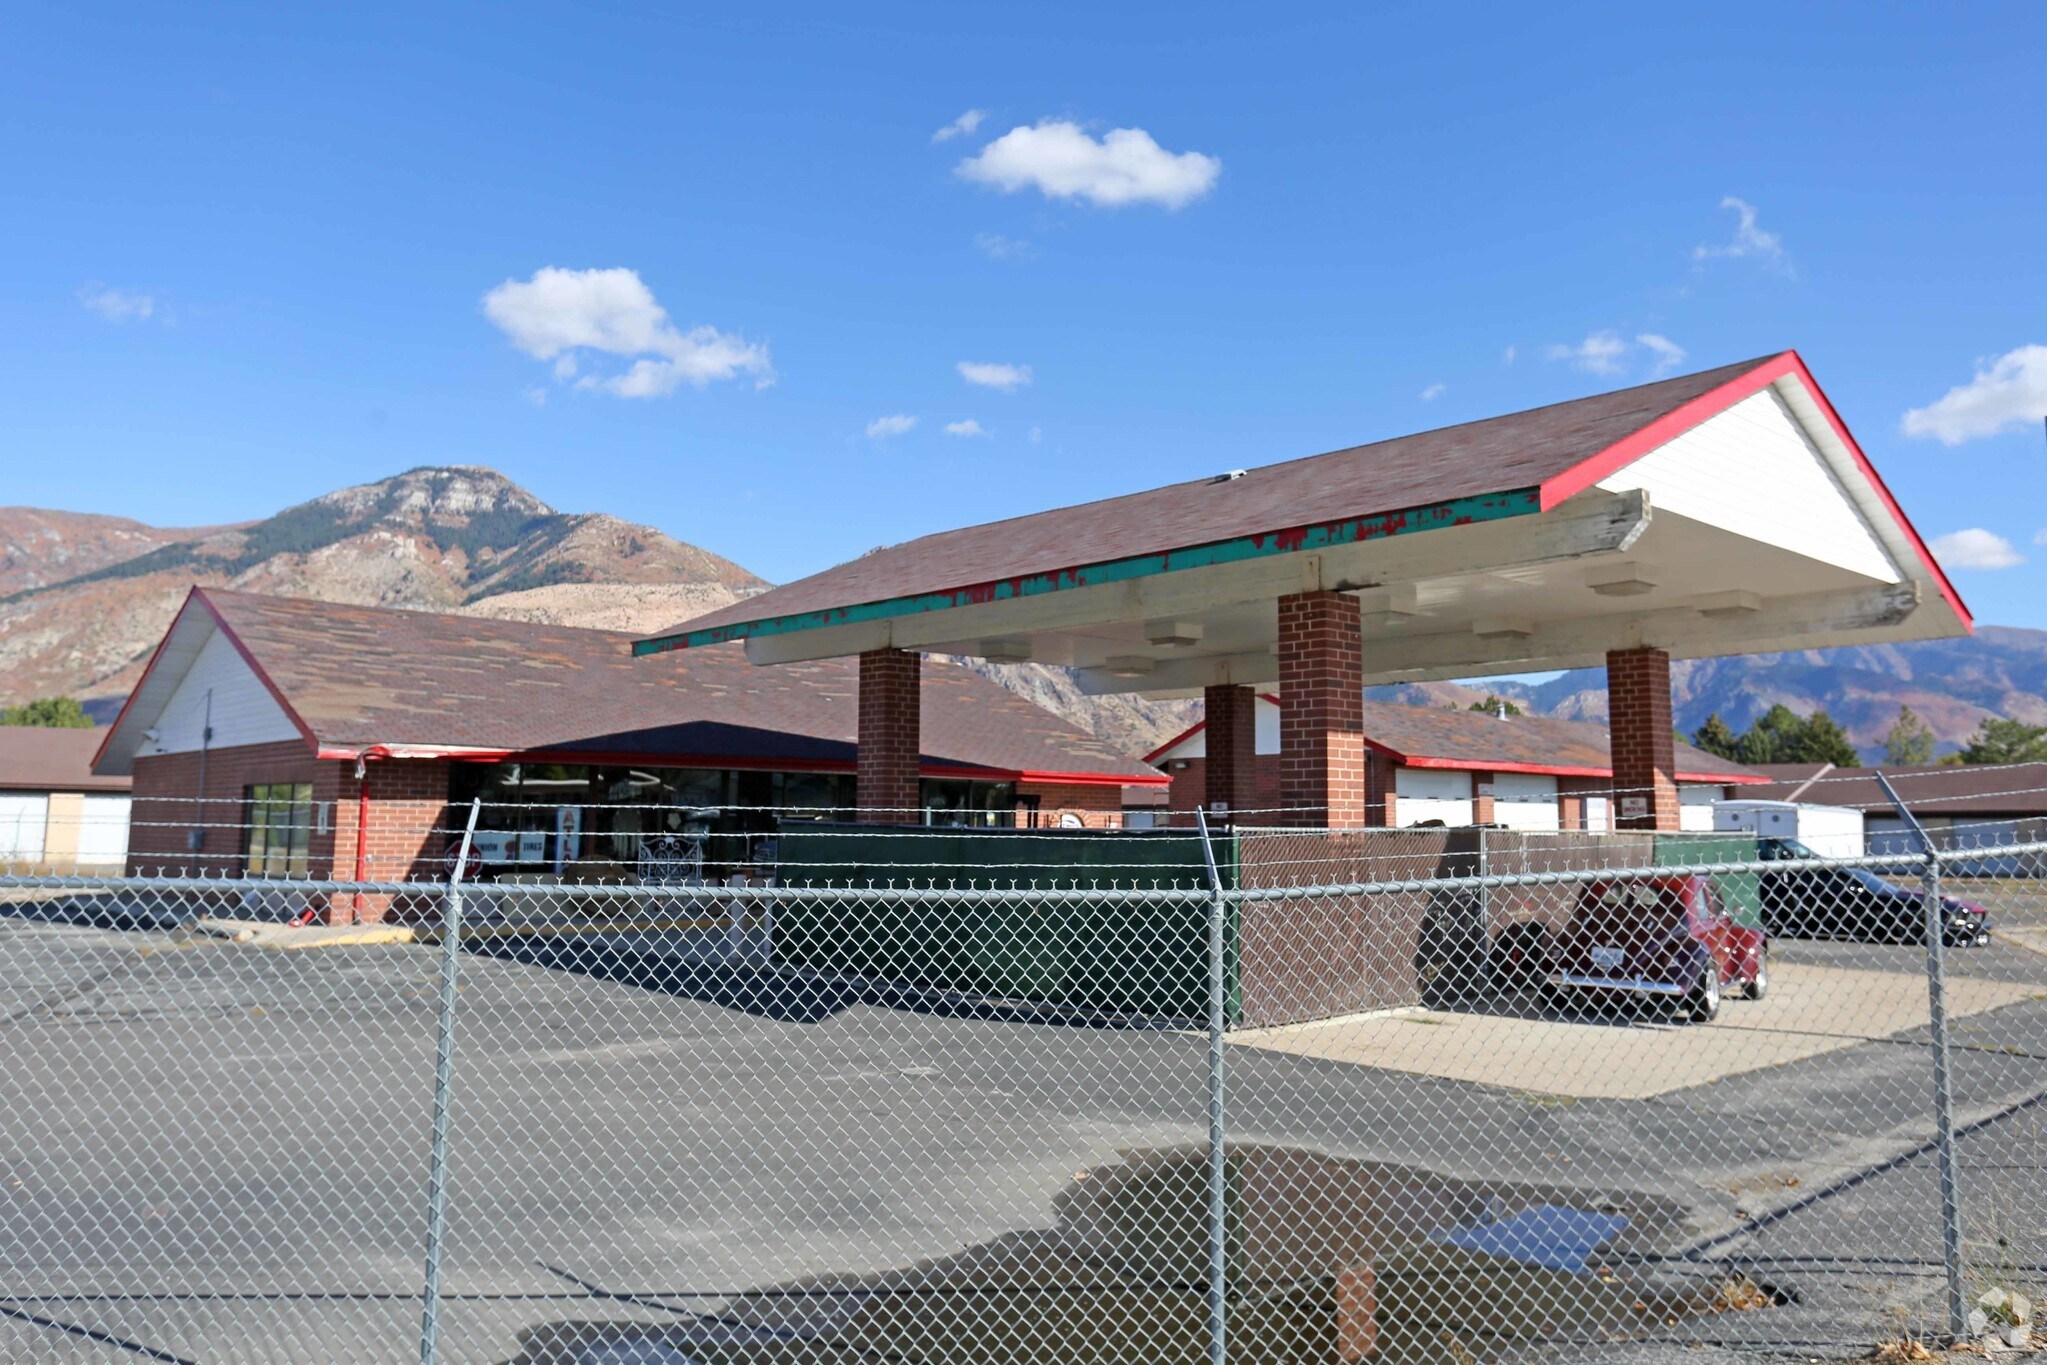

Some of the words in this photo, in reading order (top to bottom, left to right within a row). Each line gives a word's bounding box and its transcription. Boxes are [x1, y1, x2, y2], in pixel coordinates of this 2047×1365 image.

[478, 843, 498, 852] NION
[523, 842, 543, 852] TIRES
[446, 852, 480, 869] SOP
